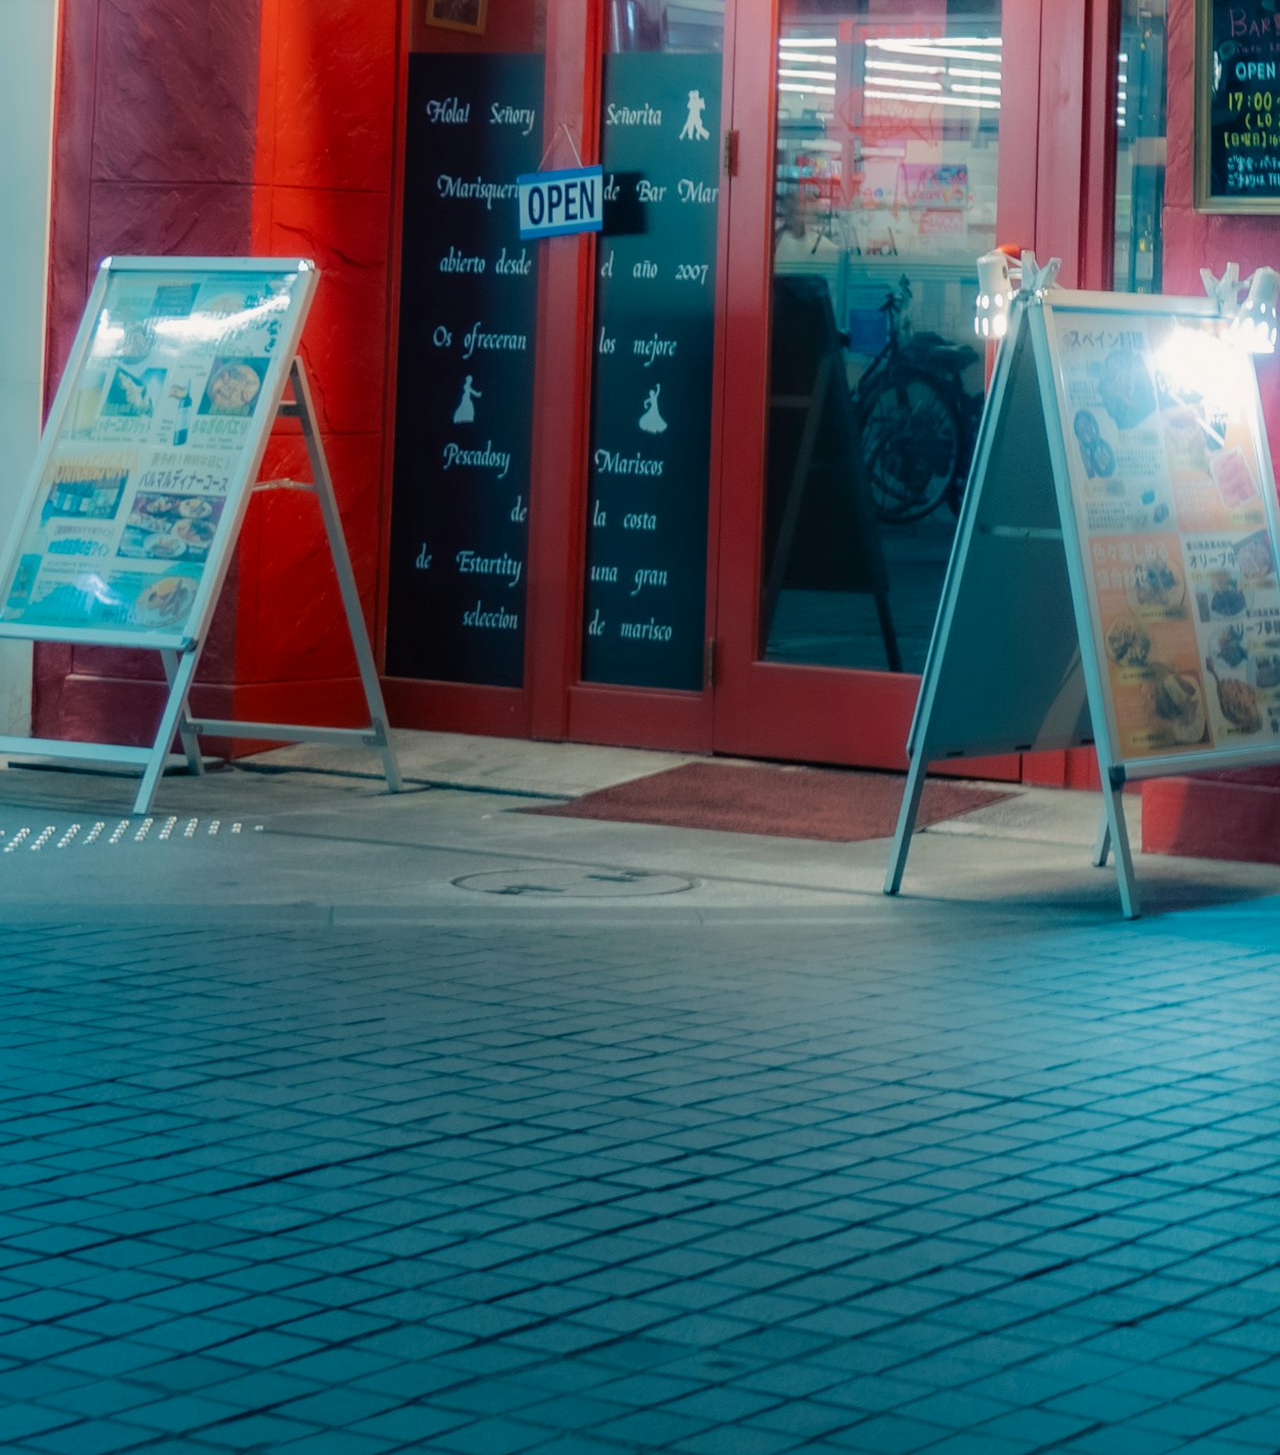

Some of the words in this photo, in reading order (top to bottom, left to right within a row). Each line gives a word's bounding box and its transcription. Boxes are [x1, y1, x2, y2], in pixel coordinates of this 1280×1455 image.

[1235, 61, 1276, 81] OPEN
[426, 97, 470, 125] Hola!
[606, 102, 662, 127] Señorita
[1227, 91, 1273, 112] 17:00
[437, 174, 520, 210] Marisqueri
[527, 178, 595, 226] OPEN
[603, 175, 620, 202] de
[636, 179, 667, 203] Bar
[677, 178, 719, 203] Mar
[439, 246, 486, 274] abierto
[495, 248, 532, 276] desde
[600, 250, 615, 278] el
[632, 258, 659, 279] año
[674, 263, 710, 285] 2007
[432, 325, 452, 348] Os
[462, 321, 527, 360] ofreceran
[598, 326, 616, 354] los
[633, 333, 678, 367] mejore
[594, 448, 664, 477] Mariscos
[510, 495, 528, 523] de
[592, 499, 607, 528] la
[622, 510, 657, 531] costa
[415, 542, 432, 570] de
[590, 565, 619, 583] una
[630, 567, 668, 596] gran
[462, 600, 519, 629] seleccion
[588, 609, 606, 636] de
[619, 616, 673, 642] marisco
